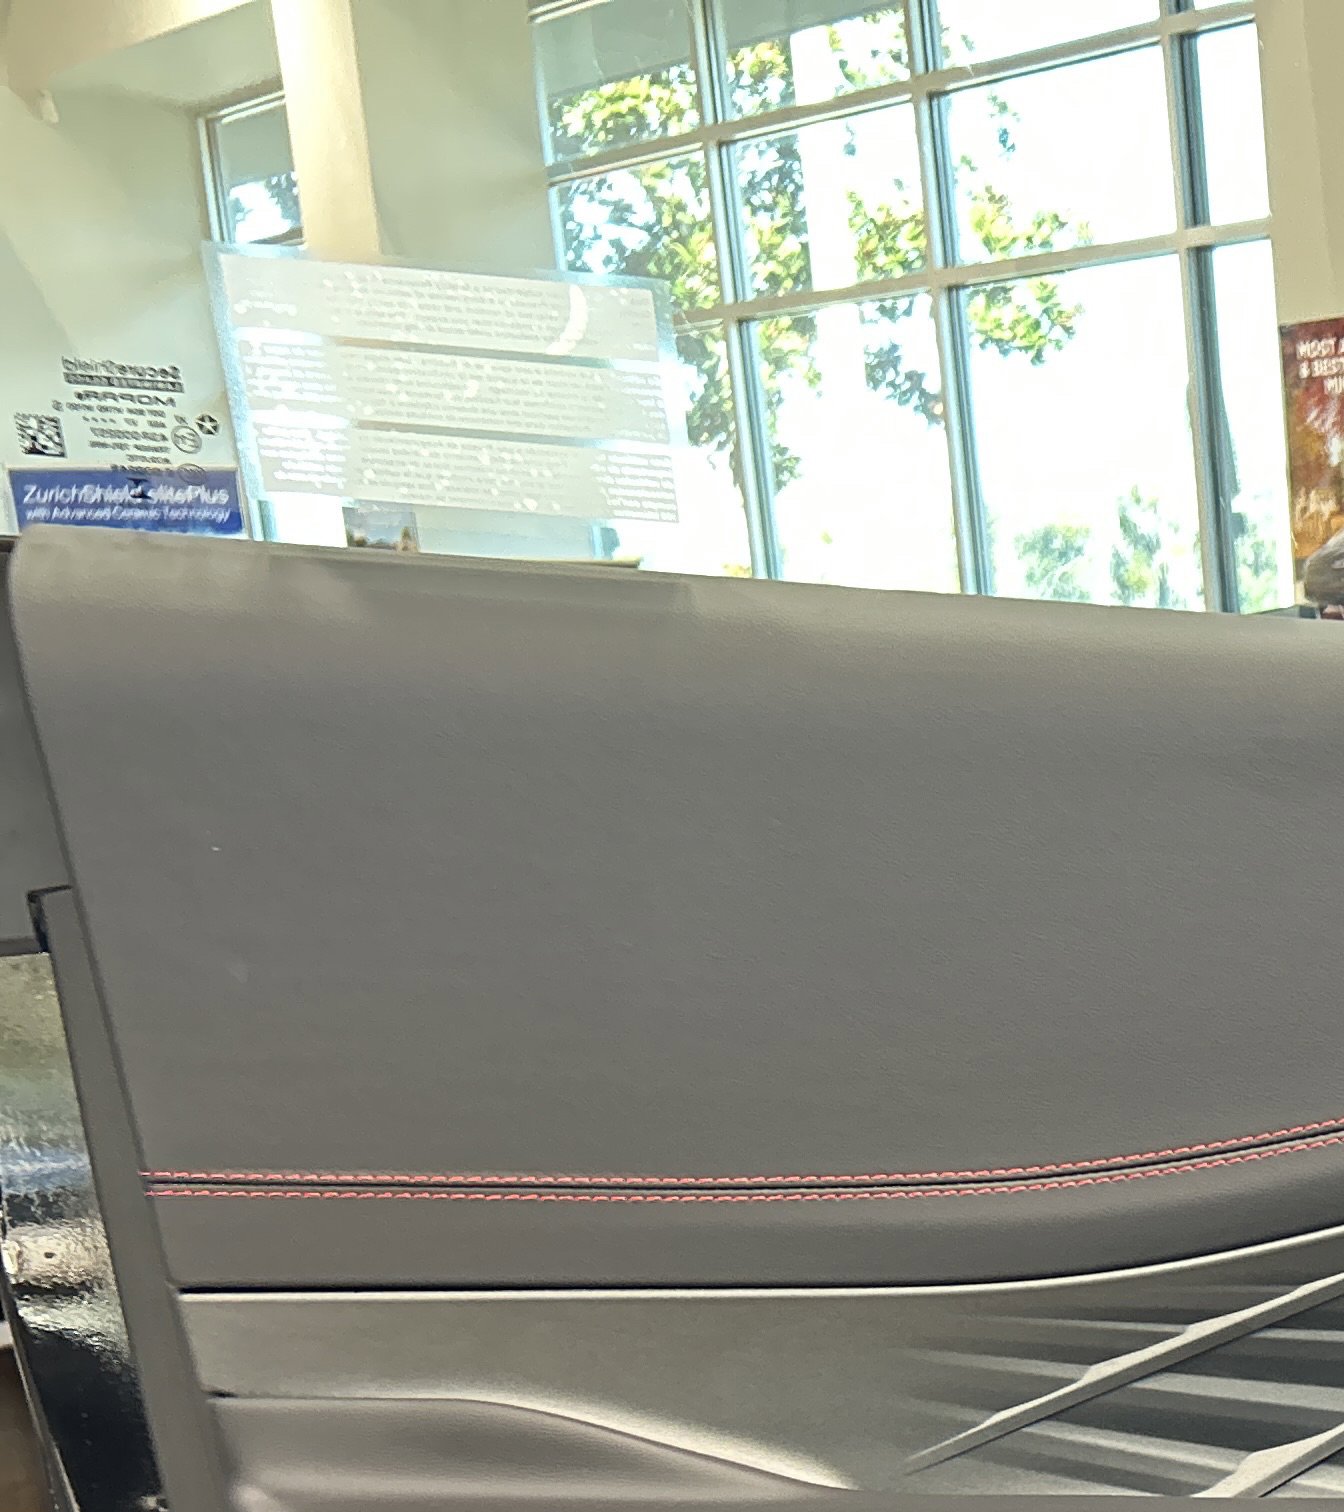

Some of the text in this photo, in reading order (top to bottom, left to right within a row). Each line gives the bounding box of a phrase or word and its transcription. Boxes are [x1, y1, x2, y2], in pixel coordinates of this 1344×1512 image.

[1296, 338, 1337, 360] MOST
[26, 507, 50, 521] with
[51, 507, 112, 522] Advanced
[163, 507, 231, 523] Technology
